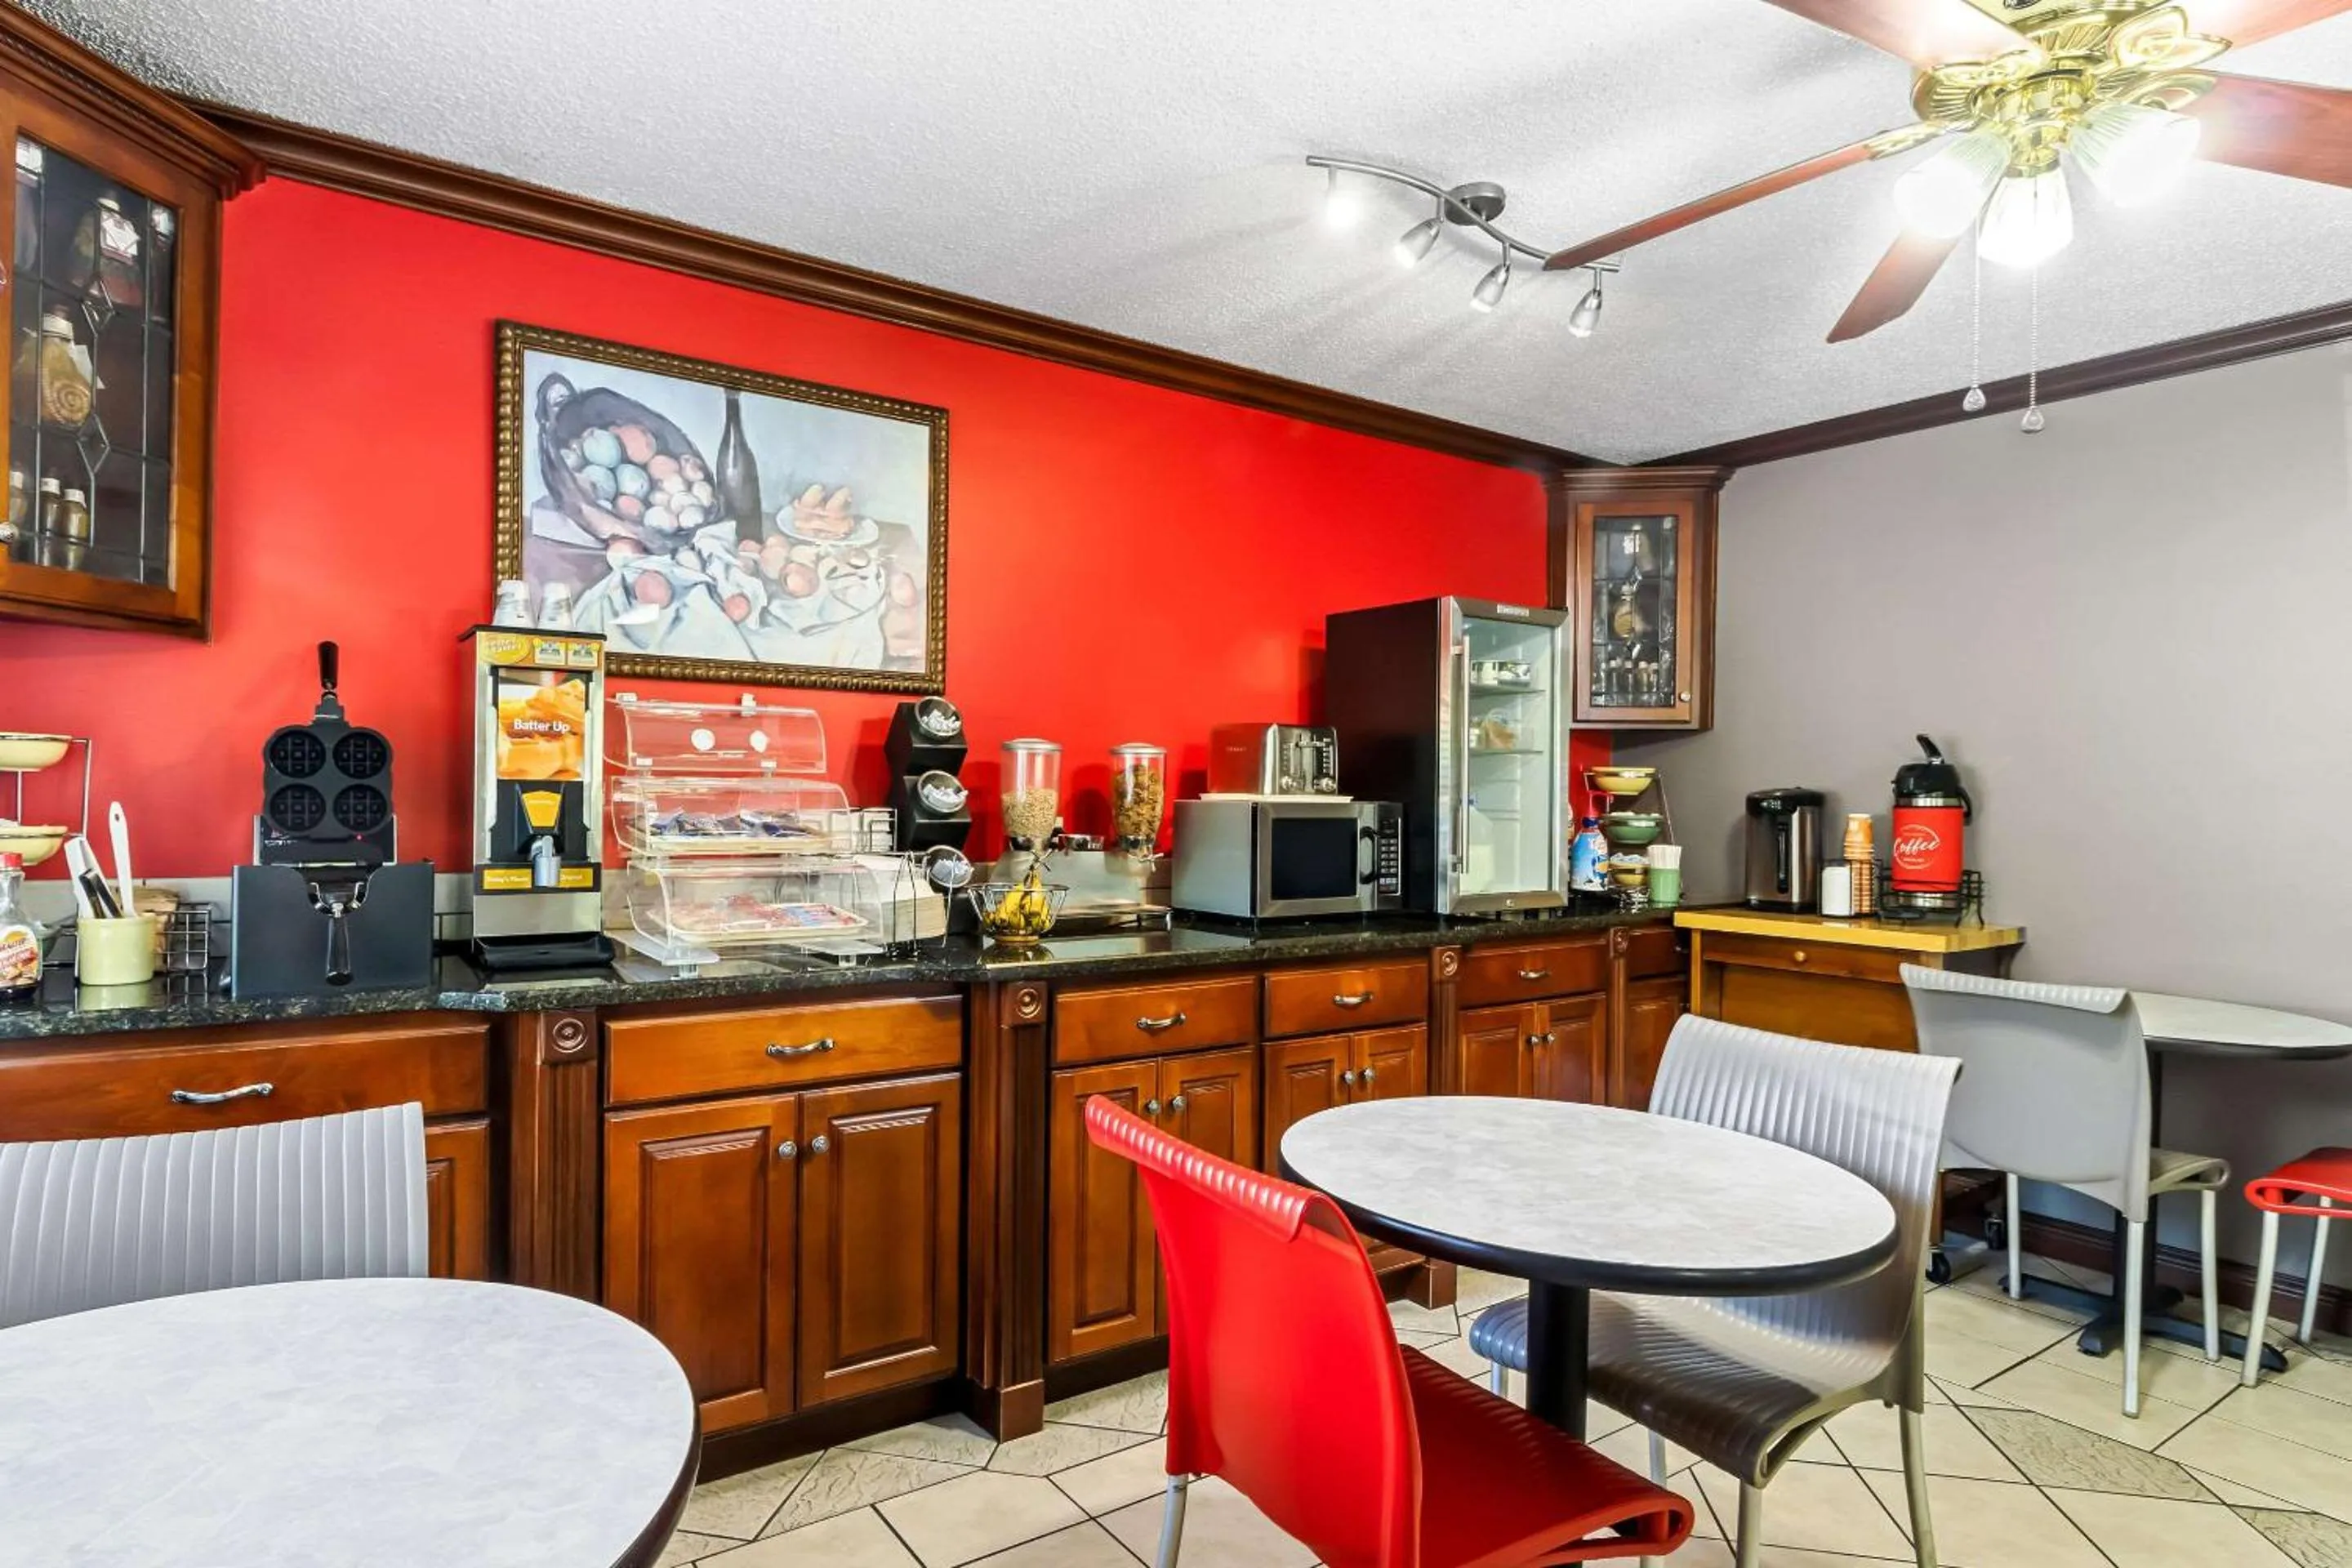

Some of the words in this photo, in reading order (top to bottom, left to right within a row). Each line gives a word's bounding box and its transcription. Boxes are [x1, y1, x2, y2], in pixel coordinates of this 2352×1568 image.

[514, 719, 550, 732] Batter
[553, 720, 570, 734] Up
[1894, 838, 1940, 856] Coffee
